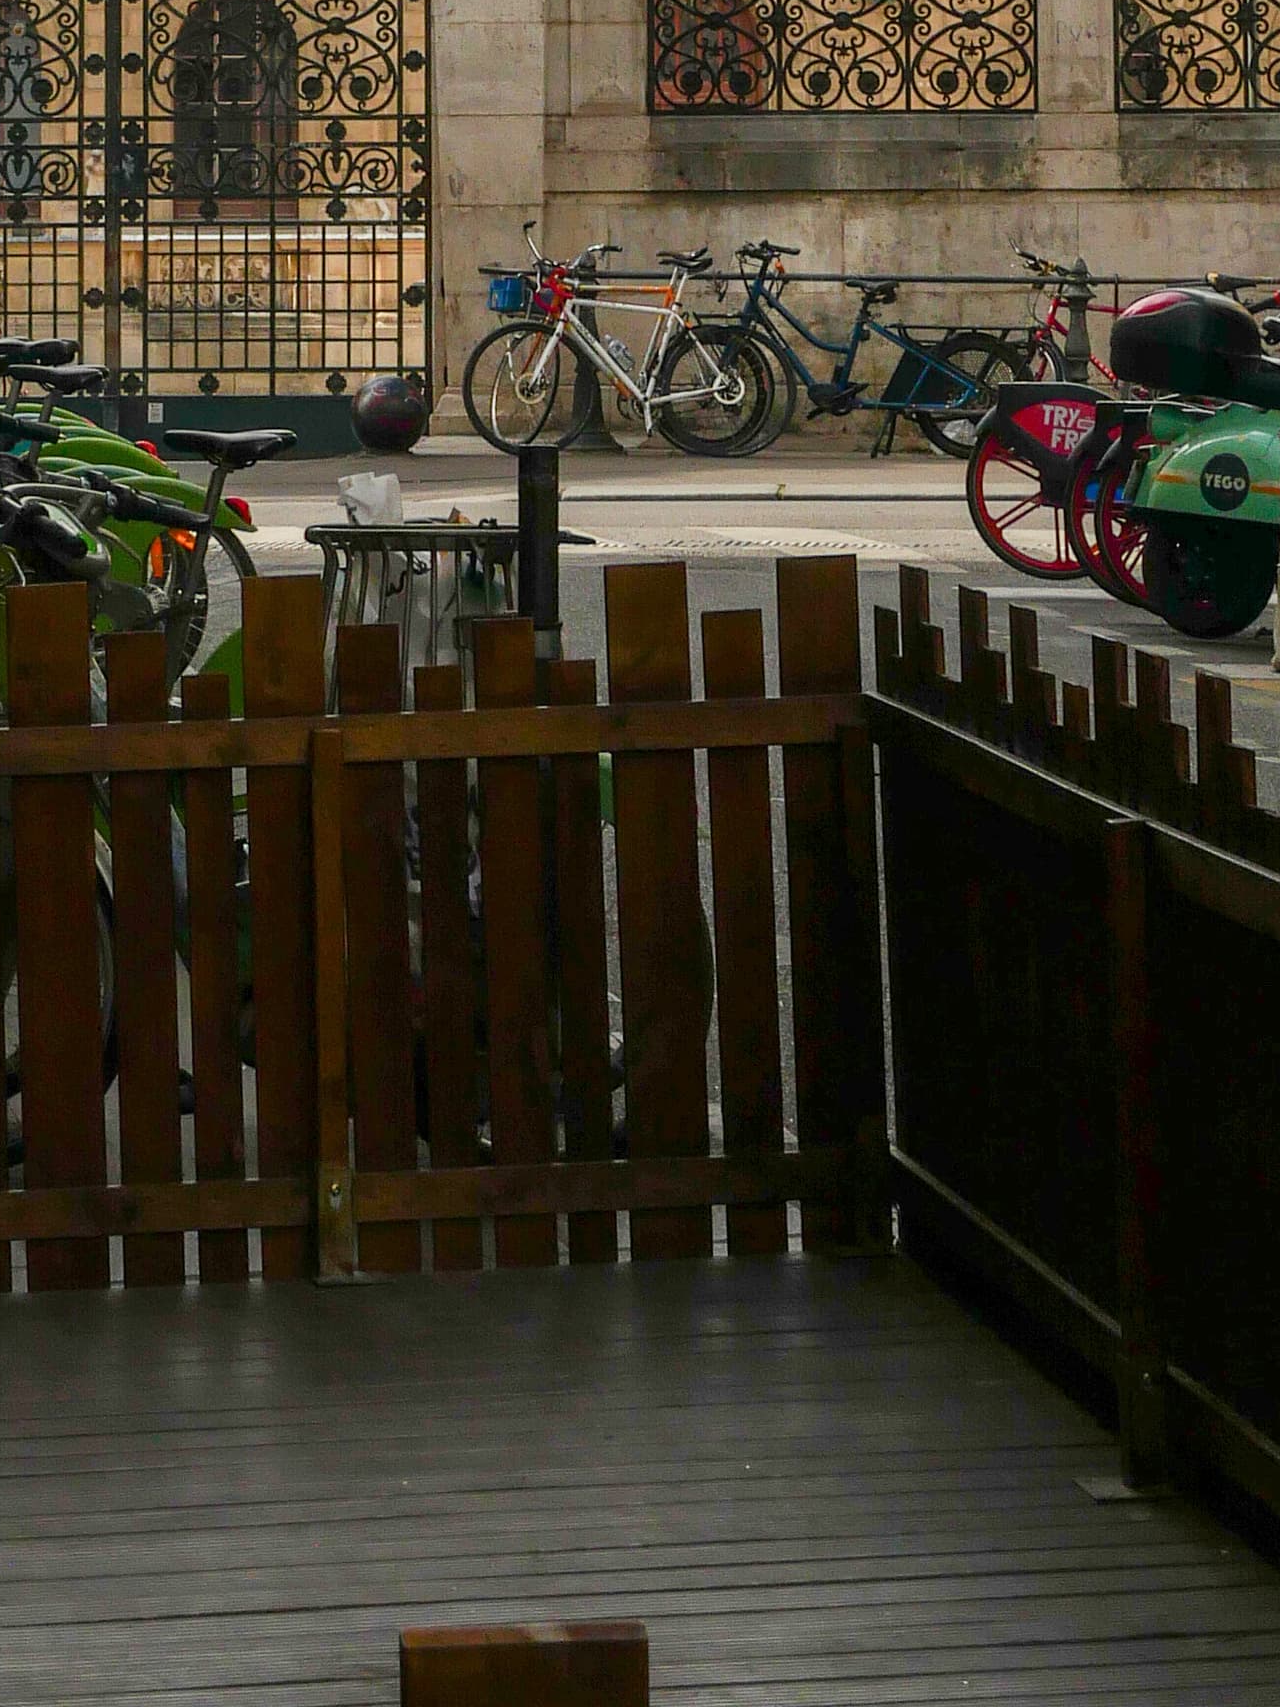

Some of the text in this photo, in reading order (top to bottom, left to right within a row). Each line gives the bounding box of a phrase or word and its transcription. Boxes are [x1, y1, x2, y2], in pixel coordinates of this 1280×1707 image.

[1042, 404, 1080, 428] TRY
[1051, 428, 1086, 451] FR
[1203, 472, 1247, 493] YEGO
